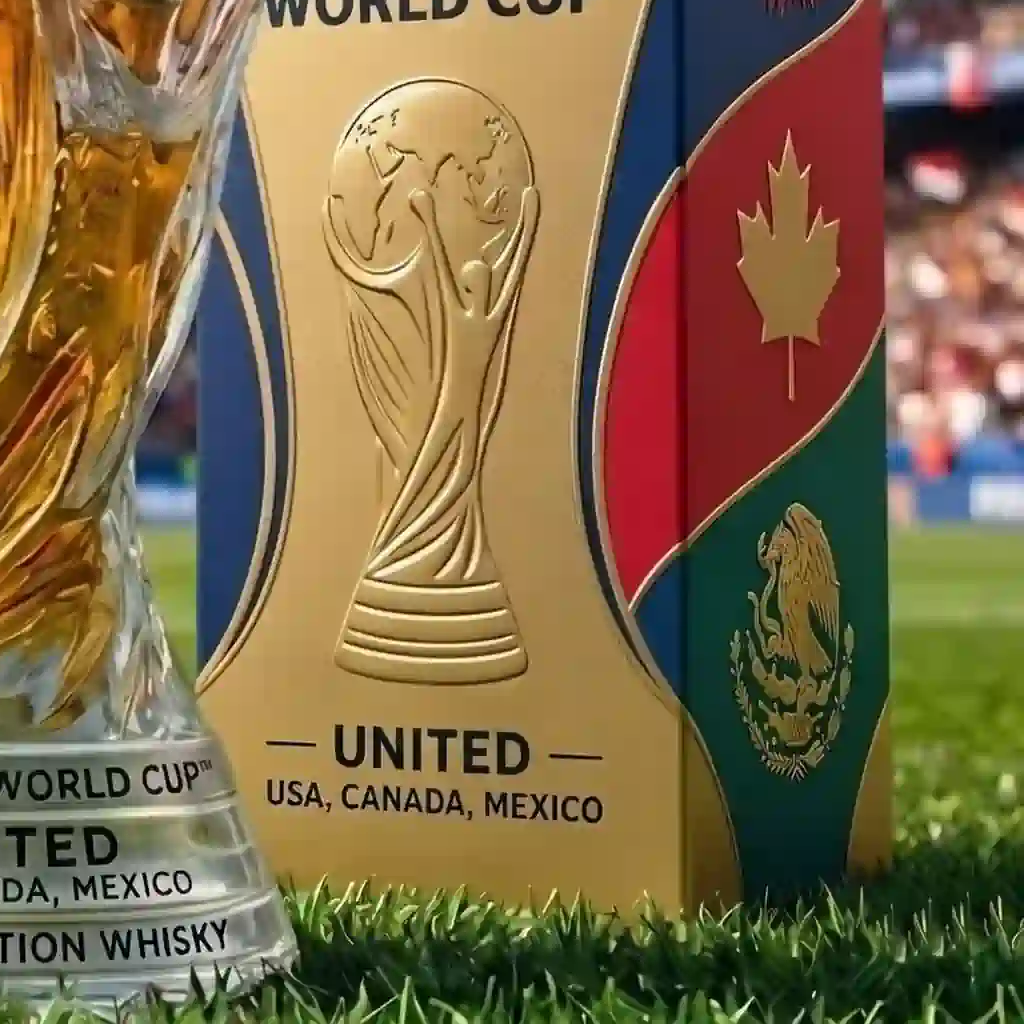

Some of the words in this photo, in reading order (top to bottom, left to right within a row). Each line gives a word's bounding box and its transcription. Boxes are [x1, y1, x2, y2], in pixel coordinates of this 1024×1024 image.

[334, 724, 531, 775] UNITED
[266, 779, 332, 813] USA,
[341, 783, 473, 821] CANADA,
[485, 791, 604, 823] MEXICO
[73, 870, 194, 901] MEXICO
[100, 918, 230, 961] WHISKY
